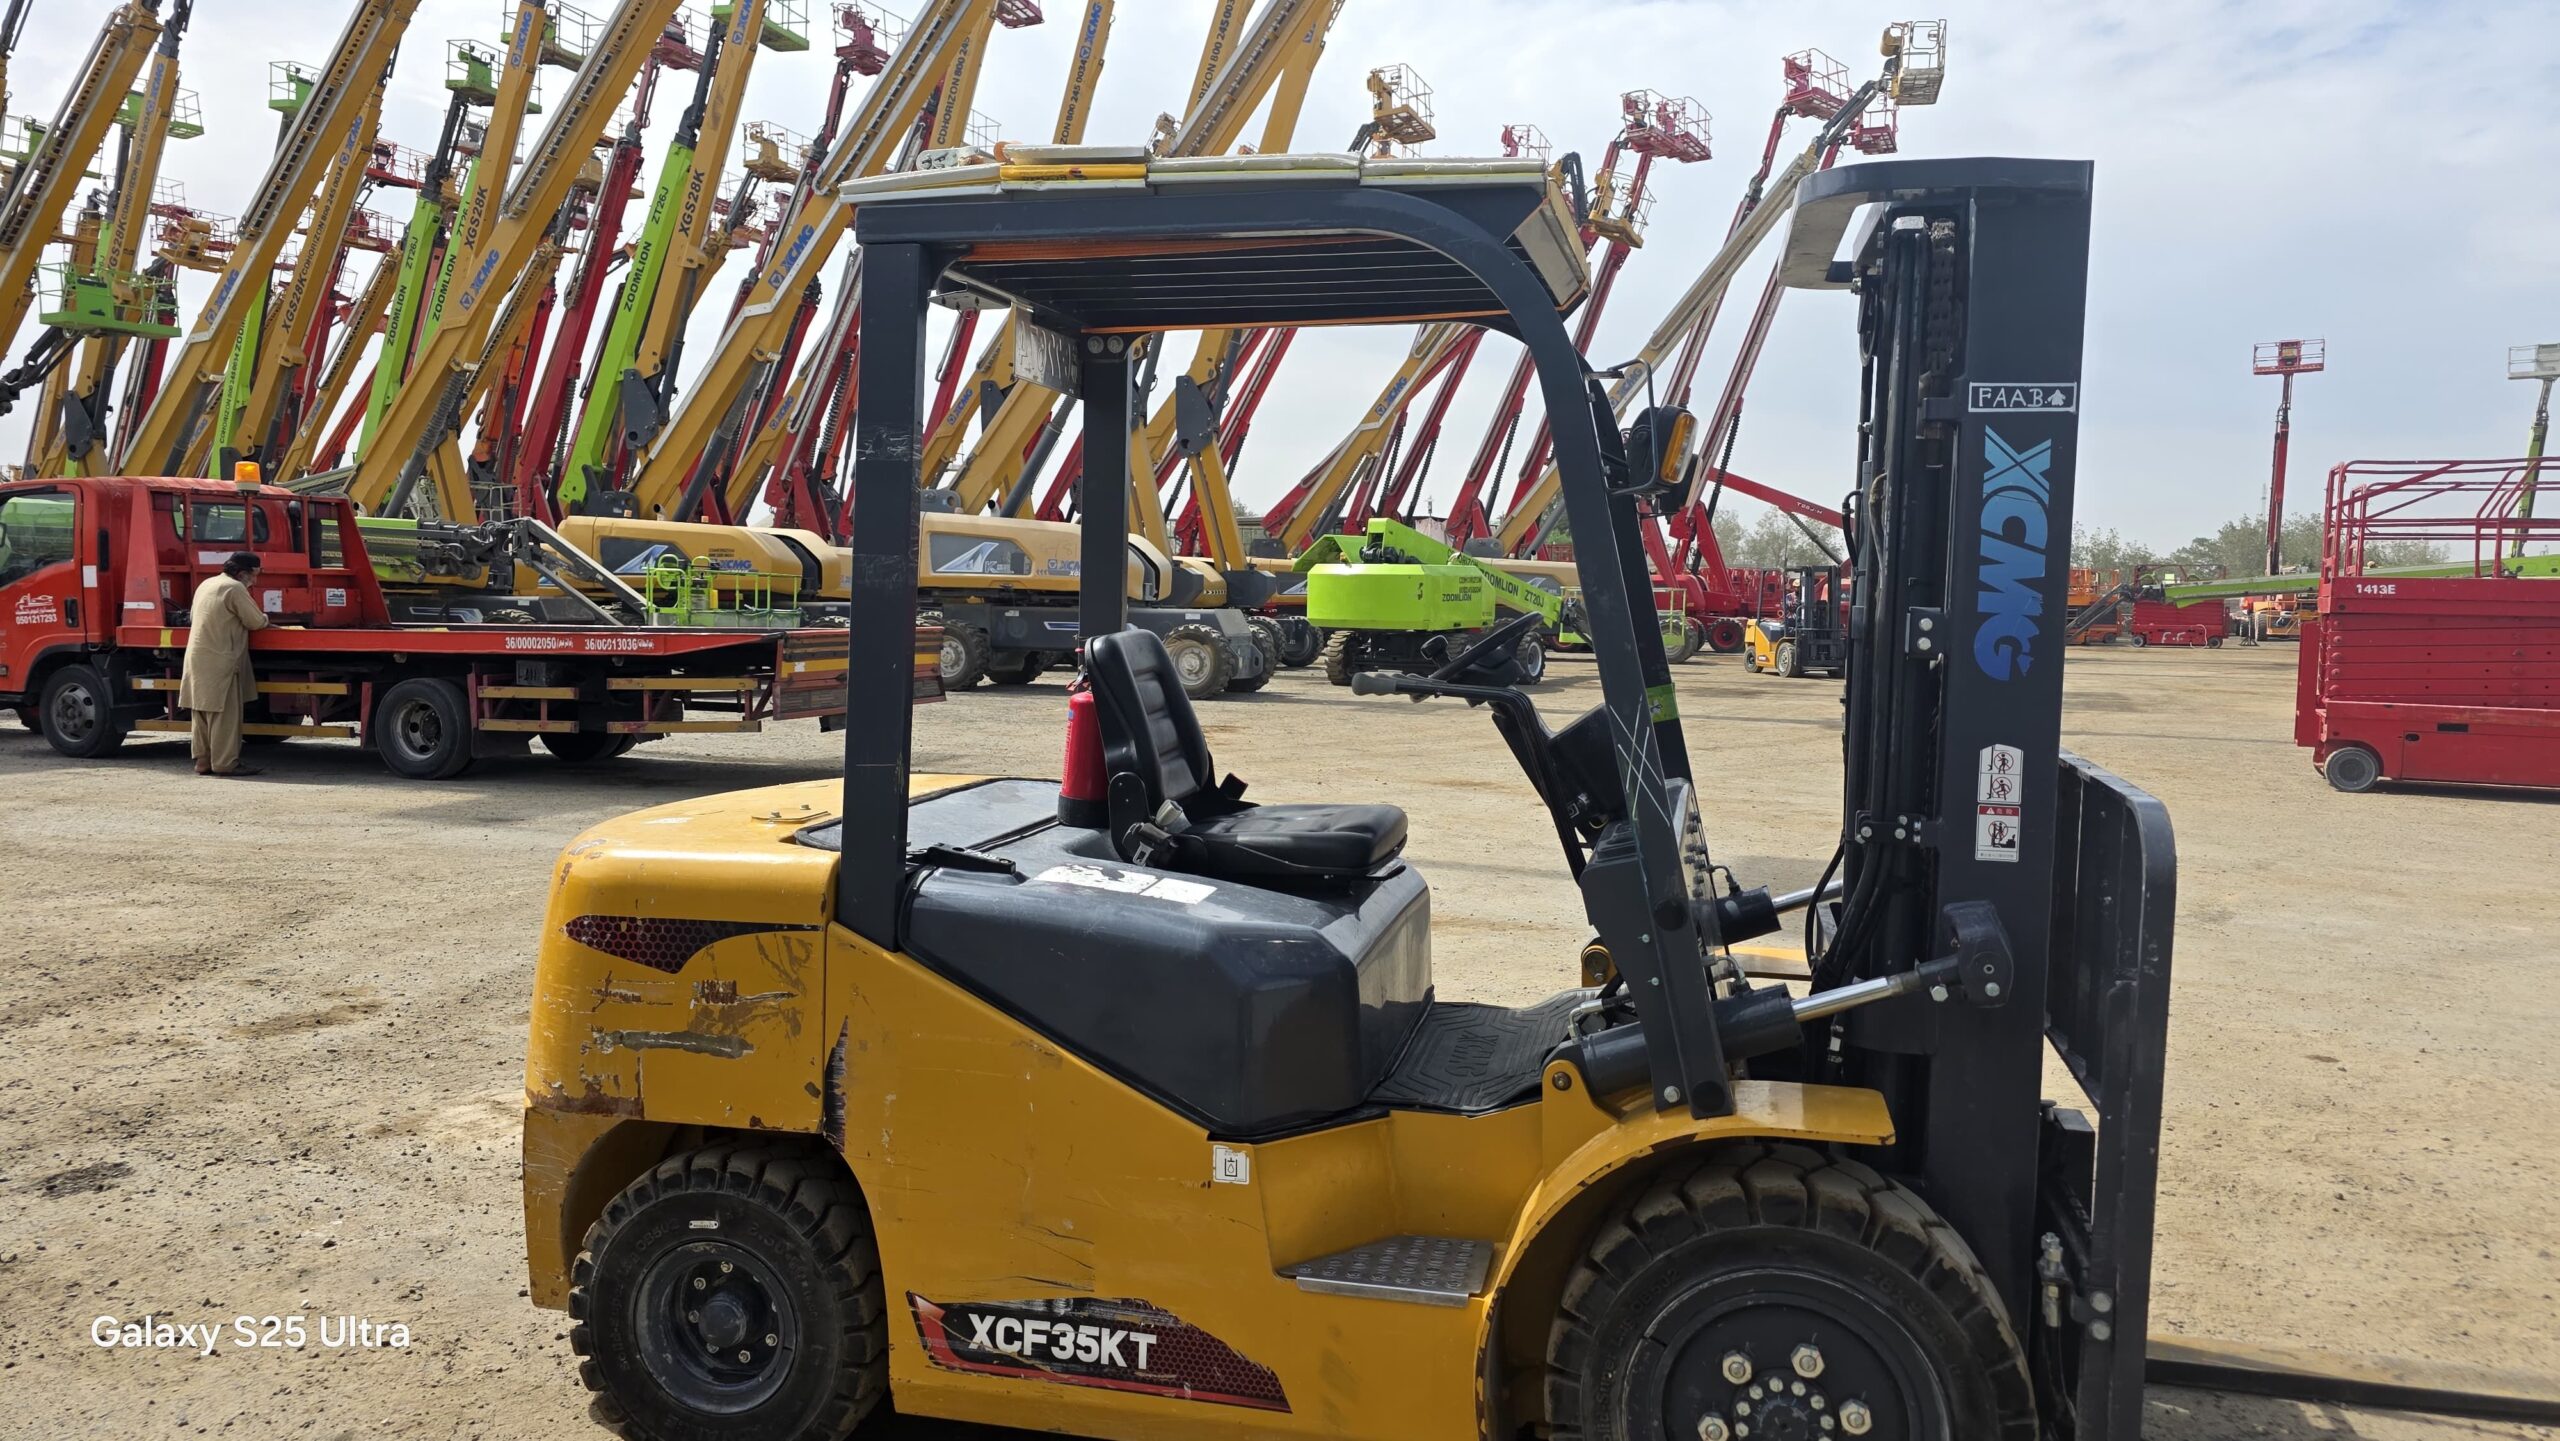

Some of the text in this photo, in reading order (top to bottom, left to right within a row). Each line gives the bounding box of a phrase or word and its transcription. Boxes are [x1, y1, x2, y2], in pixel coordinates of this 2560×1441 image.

[516, 10, 532, 53] XCMG
[1071, 85, 1080, 103] 245
[1076, 60, 1087, 83] 0034
[1085, 3, 1102, 45] XCMG
[1210, 42, 1223, 62] 800
[1217, 19, 1229, 42] 245
[937, 77, 960, 145] CDHORIZON
[464, 185, 489, 251] XGS28K
[678, 168, 705, 238] XGS28K
[282, 273, 308, 334] XGS28K
[327, 190, 337, 207] 245
[333, 166, 344, 190] 0034
[470, 249, 500, 294] XCMG
[624, 186, 670, 313] ZOOMLION ZT26J
[780, 223, 815, 273] XCMG
[215, 268, 240, 312] XCMG
[387, 236, 419, 347] ZOOMLION ZT26J
[432, 254, 457, 322] ZOOMLION
[719, 559, 752, 570] XCMG
[1973, 424, 2052, 682] XCMG
[1441, 593, 1472, 602] ZOOMLION
[2356, 583, 2397, 595] 1413E
[16, 613, 58, 625] 0501217293
[1444, 1029, 1500, 1077] XCMG
[968, 1313, 1157, 1370] XCF35KT
